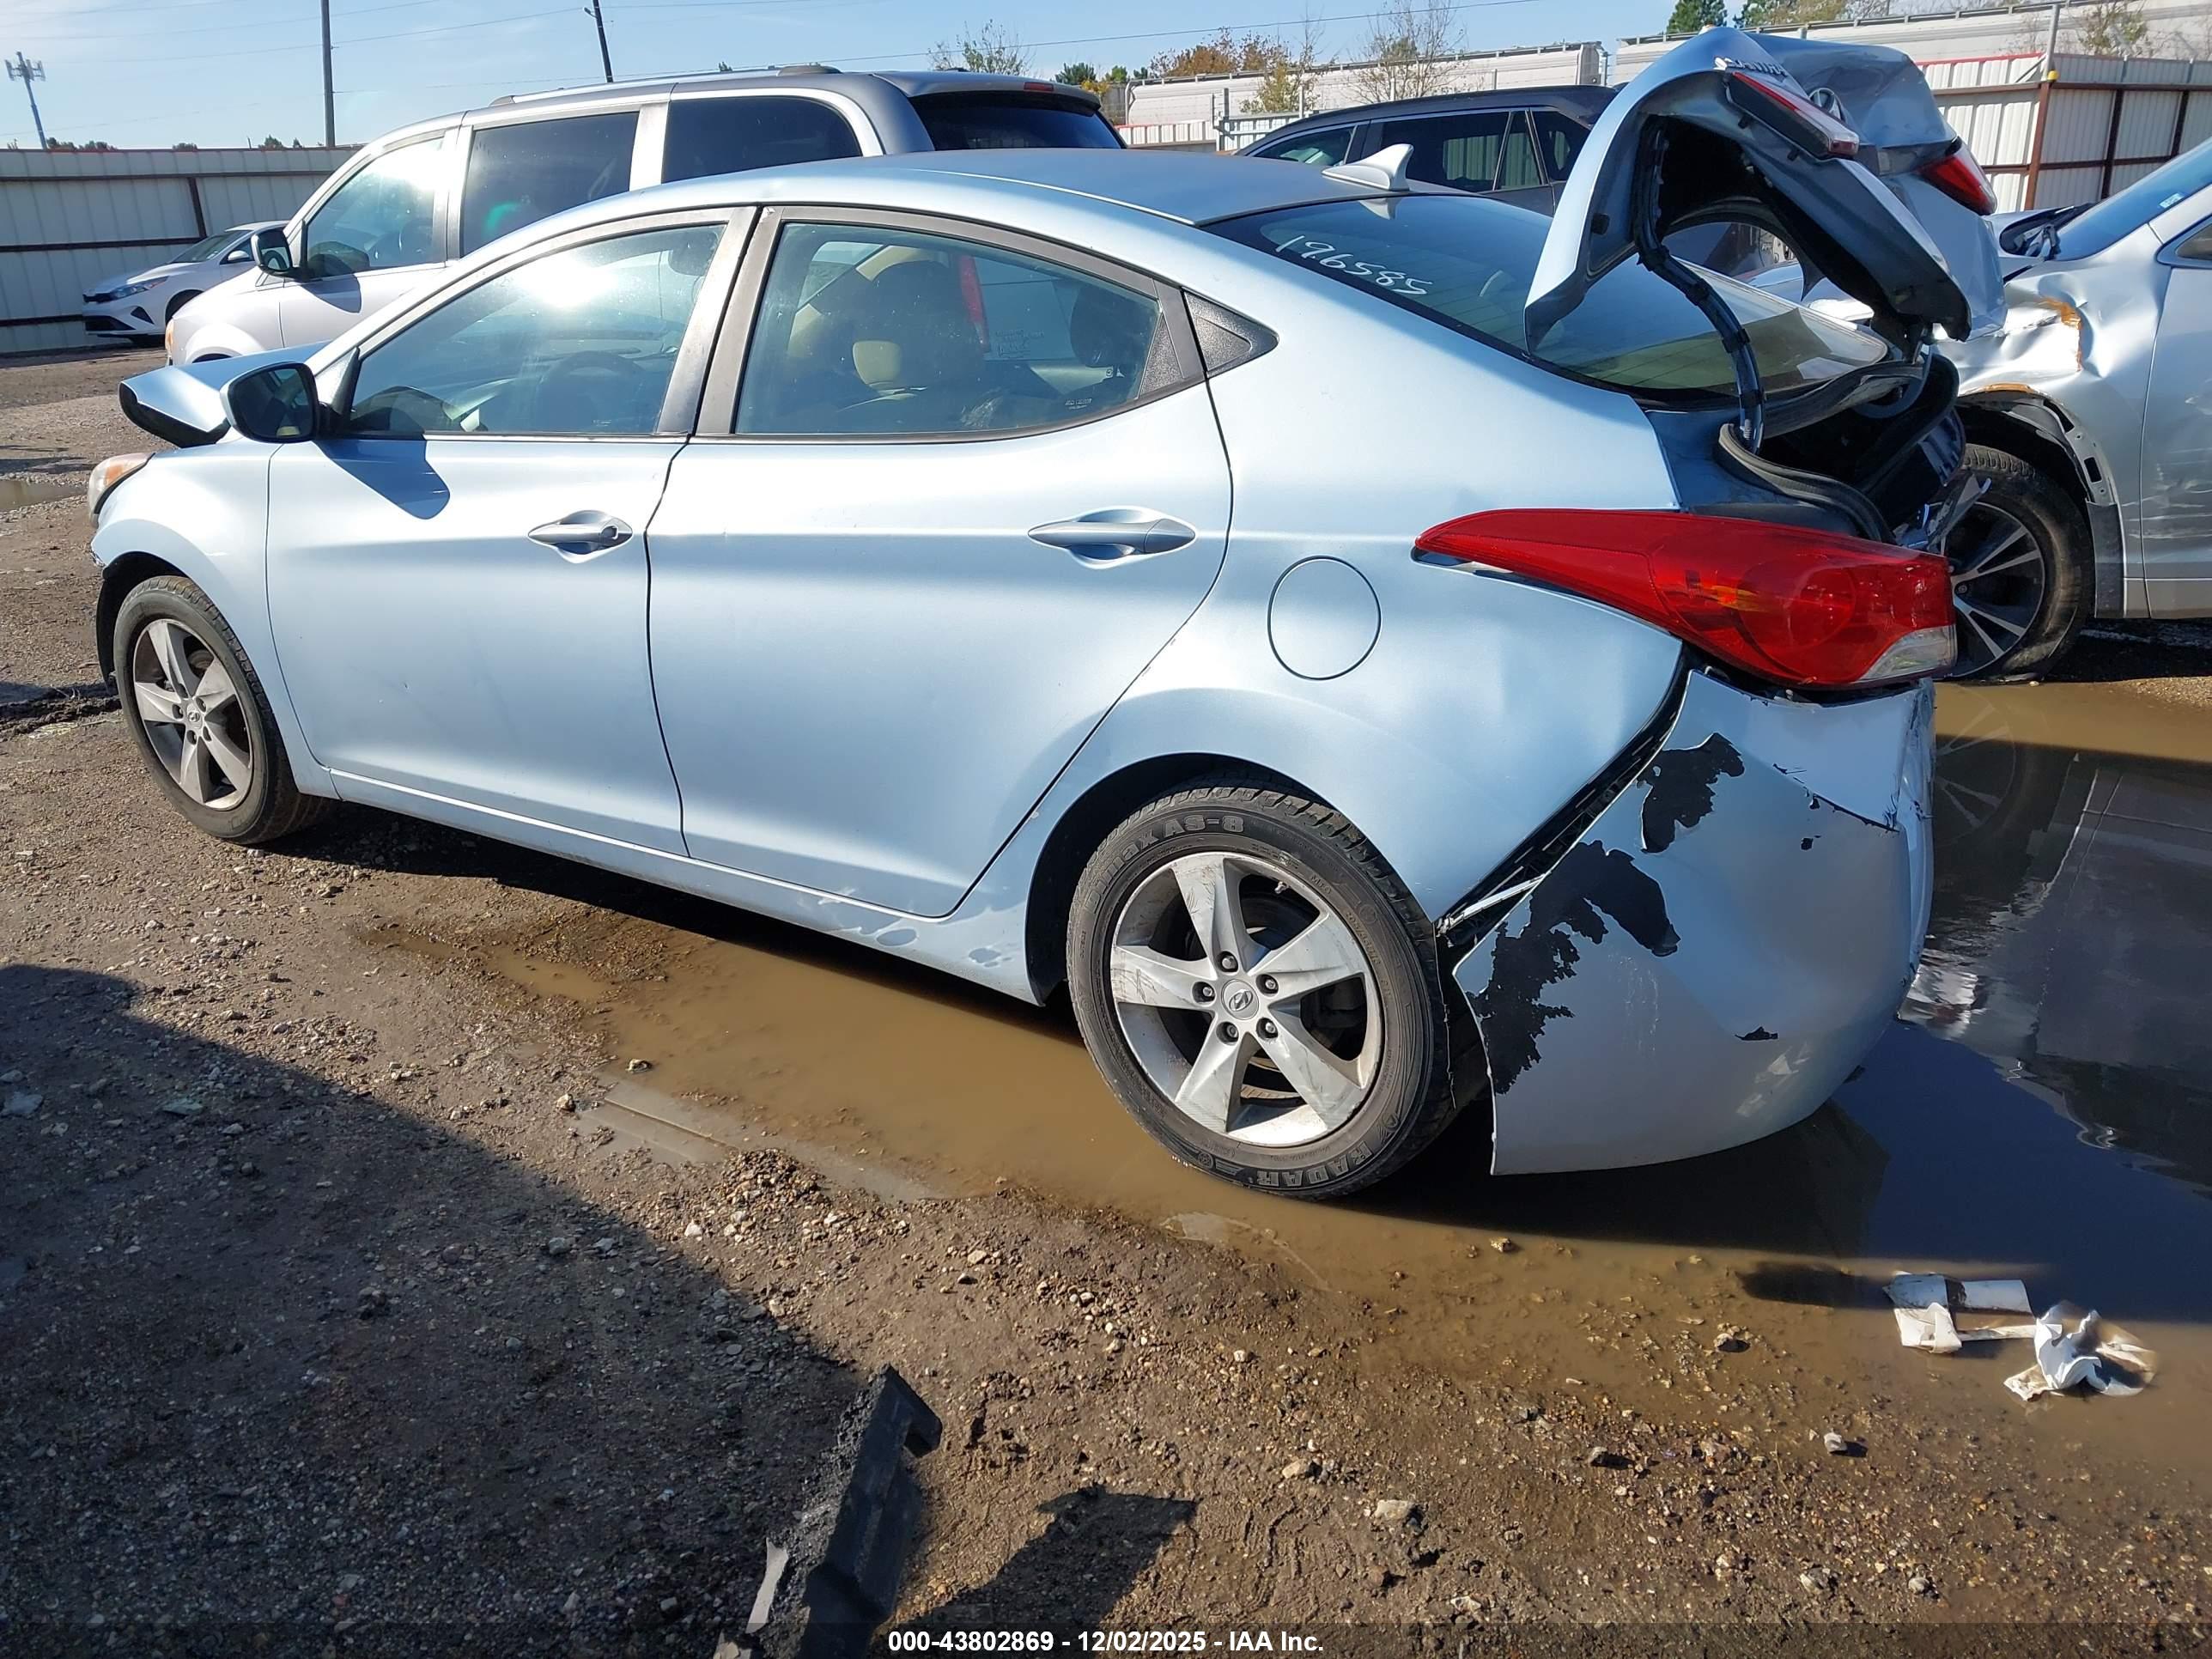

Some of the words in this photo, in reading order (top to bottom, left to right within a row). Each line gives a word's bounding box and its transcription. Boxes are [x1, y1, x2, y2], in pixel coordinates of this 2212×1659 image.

[1275, 235, 1433, 295] 196585
[1085, 831, 1159, 915] Dimax
[1164, 814, 1245, 837] AS-8
[1256, 1139, 1374, 1188] RADAR
